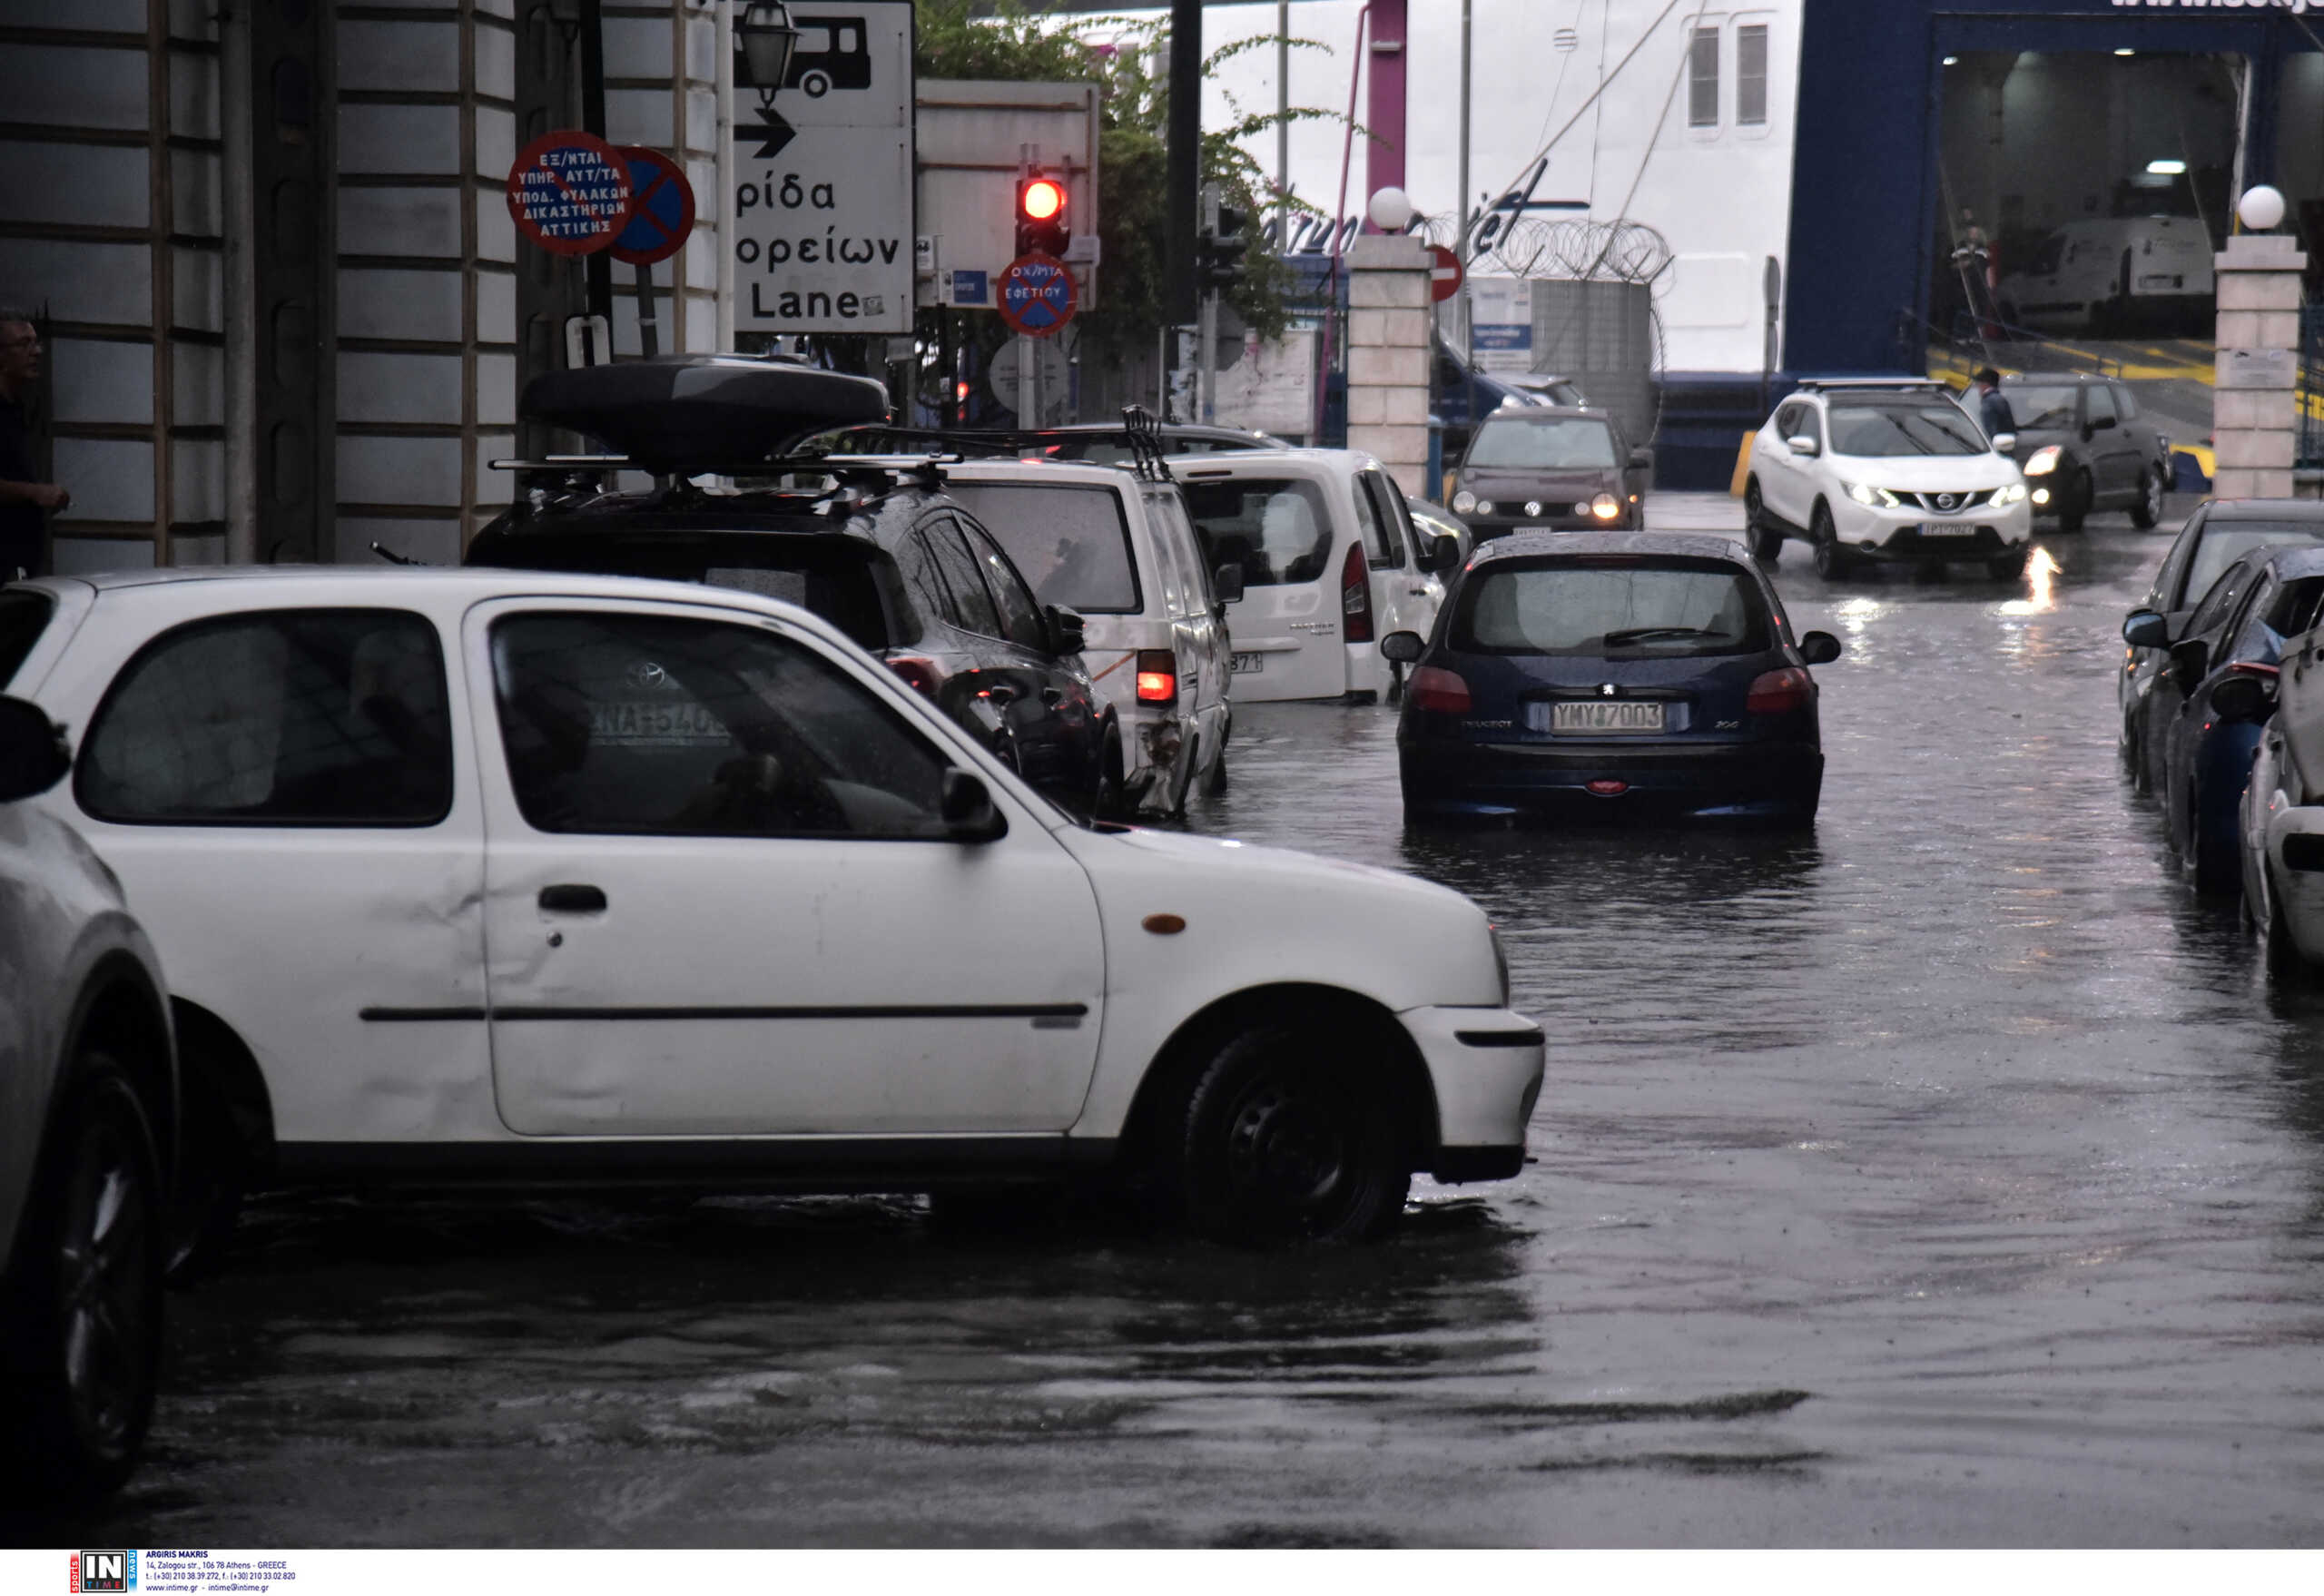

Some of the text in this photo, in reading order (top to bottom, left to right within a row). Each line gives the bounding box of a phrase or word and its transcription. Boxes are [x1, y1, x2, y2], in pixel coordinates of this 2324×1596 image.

[566, 167, 621, 182] ΑΥΤ/ΤΑ
[512, 186, 629, 204] ΥΠΟΔ. ΦΥΛΑΚΩΝ
[523, 203, 625, 220] ΔΙΚΑΣΤΗΡΙΩΝ
[540, 221, 611, 237] ΑΤΤΙΚΗΣ
[752, 282, 859, 319] Lane
